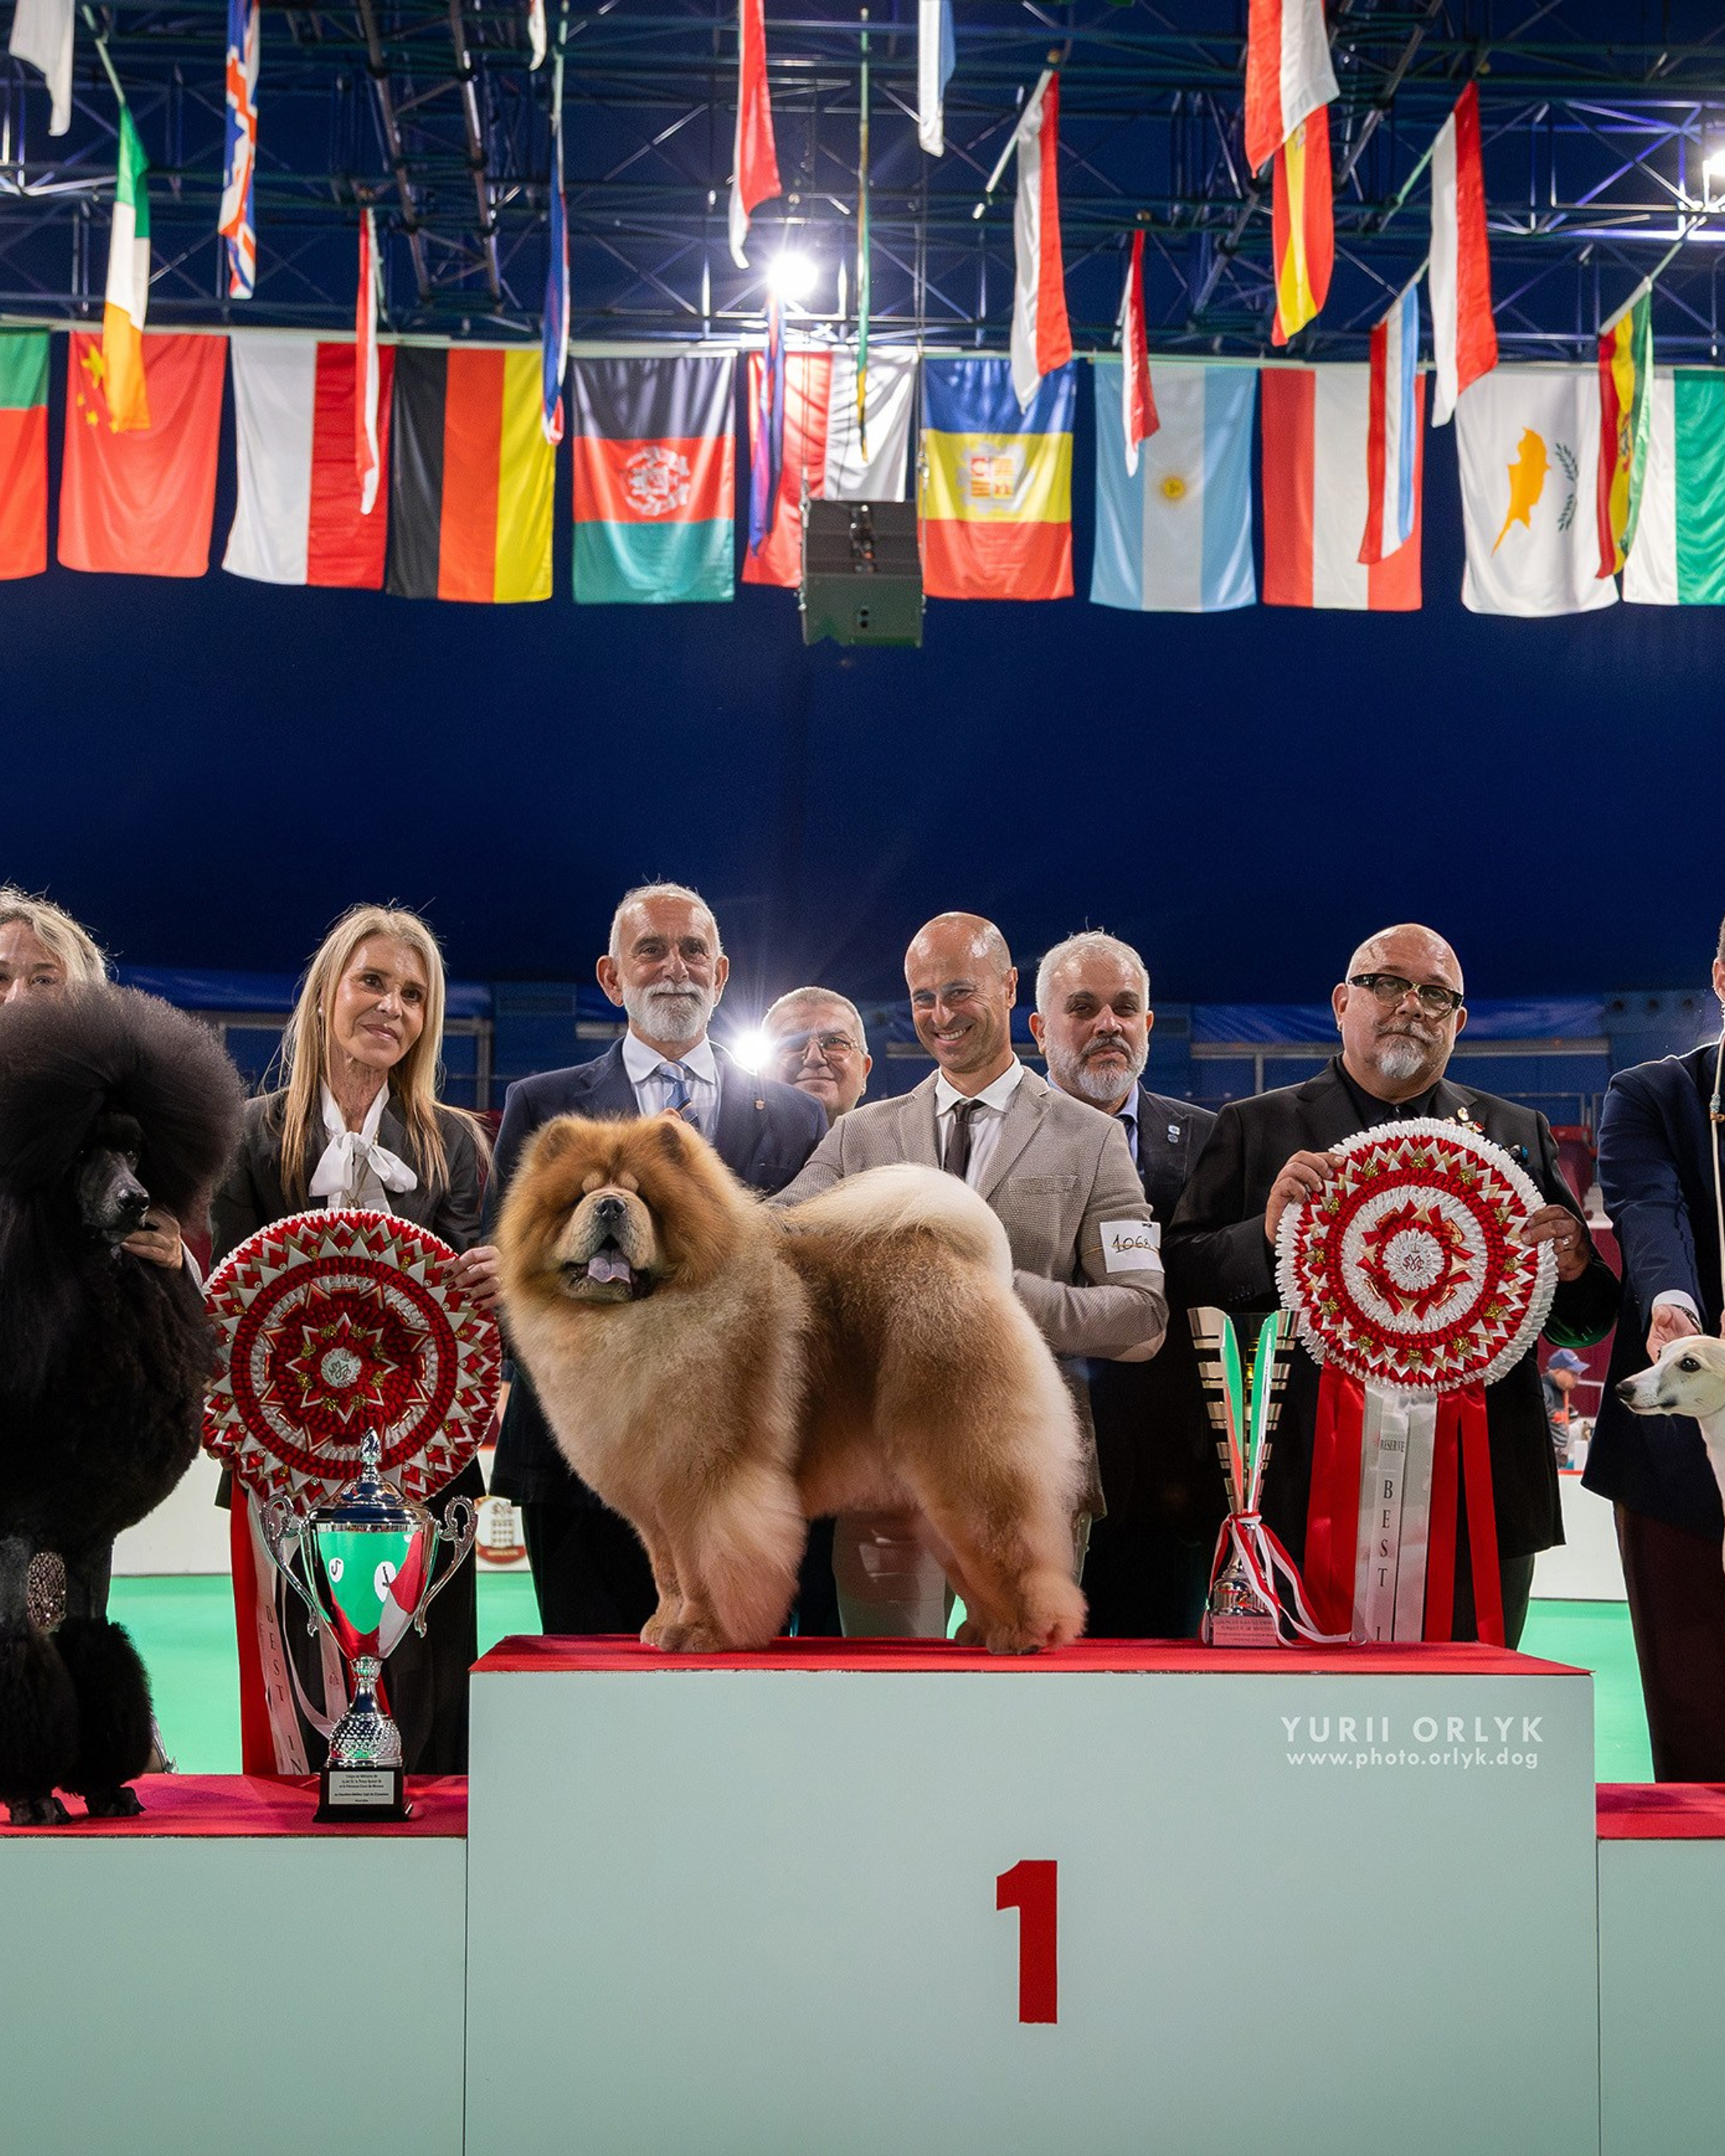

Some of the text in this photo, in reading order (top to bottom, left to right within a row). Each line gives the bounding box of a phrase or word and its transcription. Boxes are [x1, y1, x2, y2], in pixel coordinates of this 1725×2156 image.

[1378, 1479, 1393, 1587] BEST
[265, 1605, 284, 1702] BEST
[996, 1860, 1057, 2024] 1
